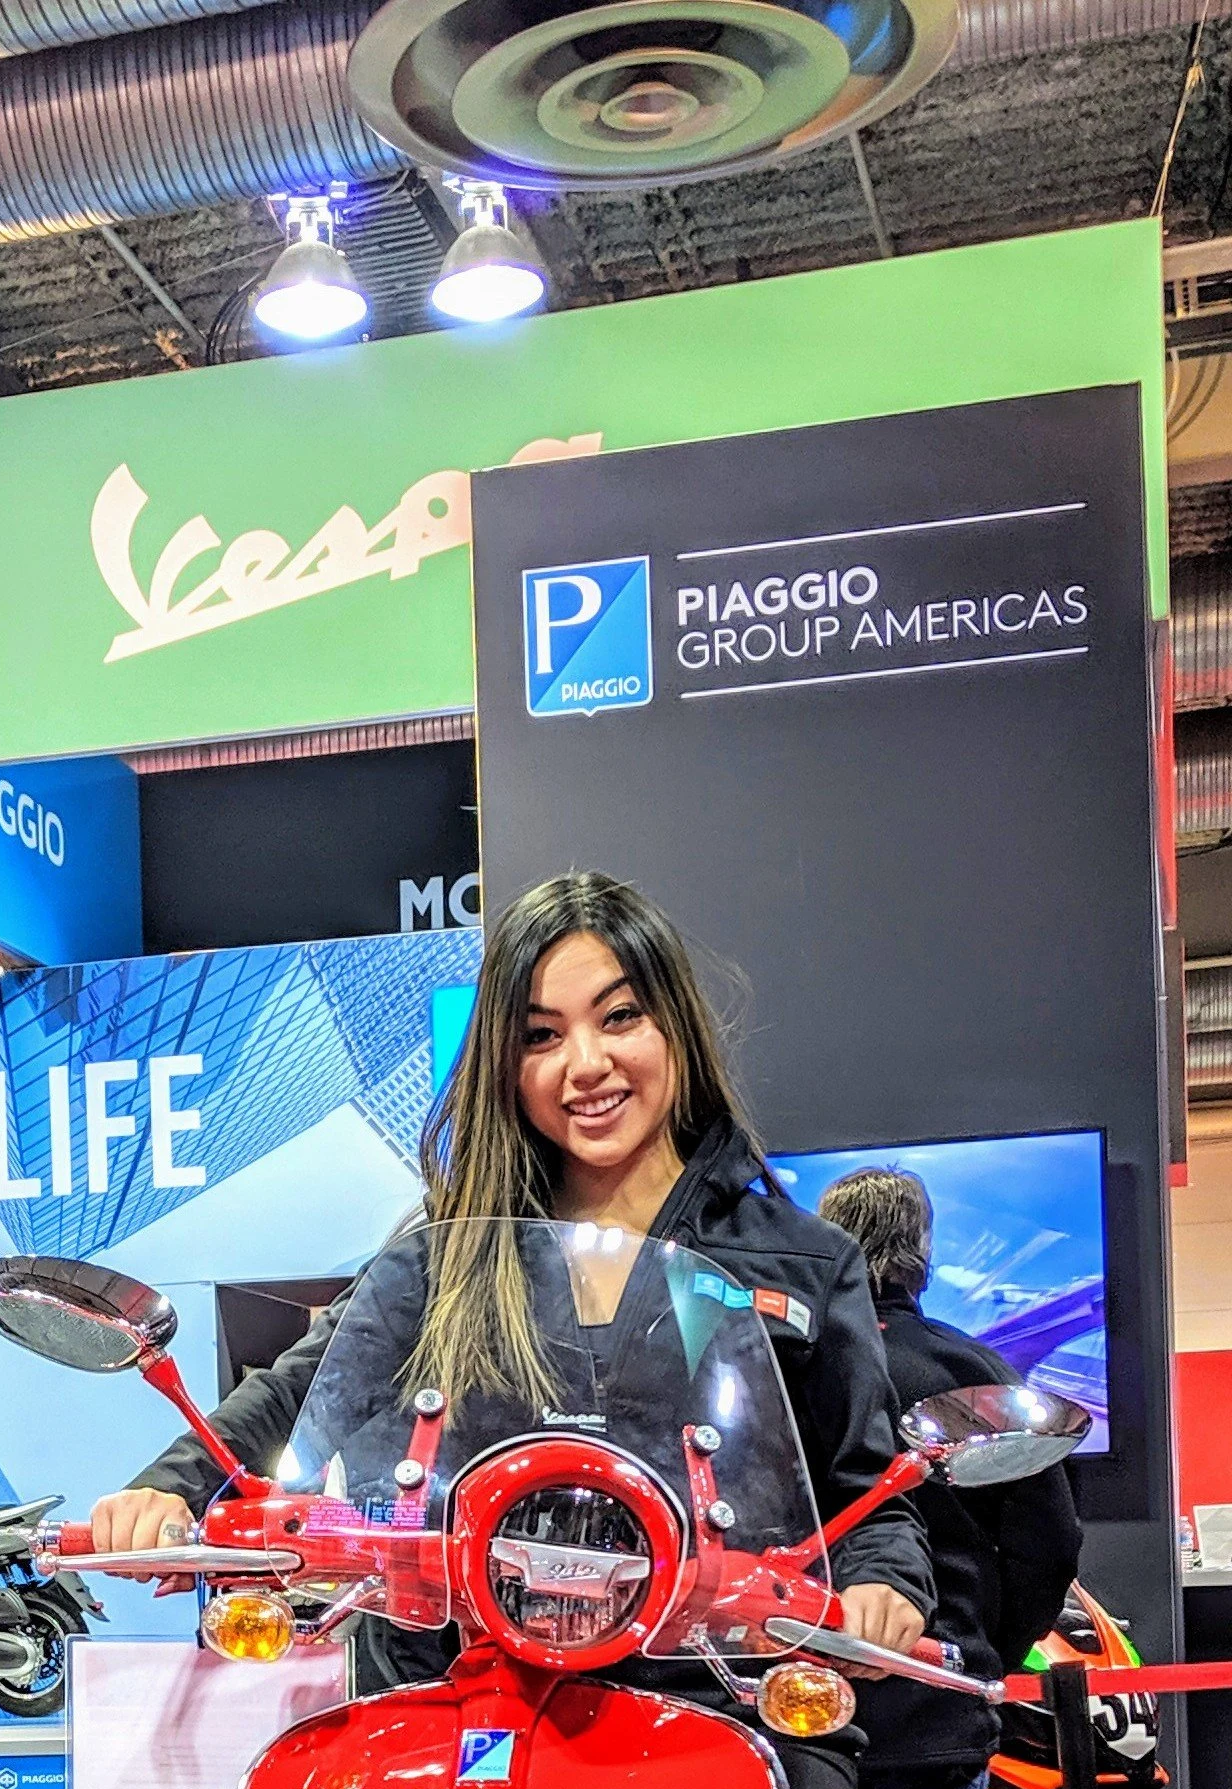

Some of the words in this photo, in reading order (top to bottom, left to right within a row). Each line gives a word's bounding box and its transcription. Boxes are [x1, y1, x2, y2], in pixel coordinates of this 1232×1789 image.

[677, 564, 880, 627] PIAGGIO
[532, 575, 602, 676] P
[676, 617, 840, 670] GROUP
[850, 584, 1089, 653] AMERICAS
[561, 675, 641, 703] PIAGGIO
[465, 1733, 493, 1763] P
[21, 1774, 64, 1784] PIAGGIO
